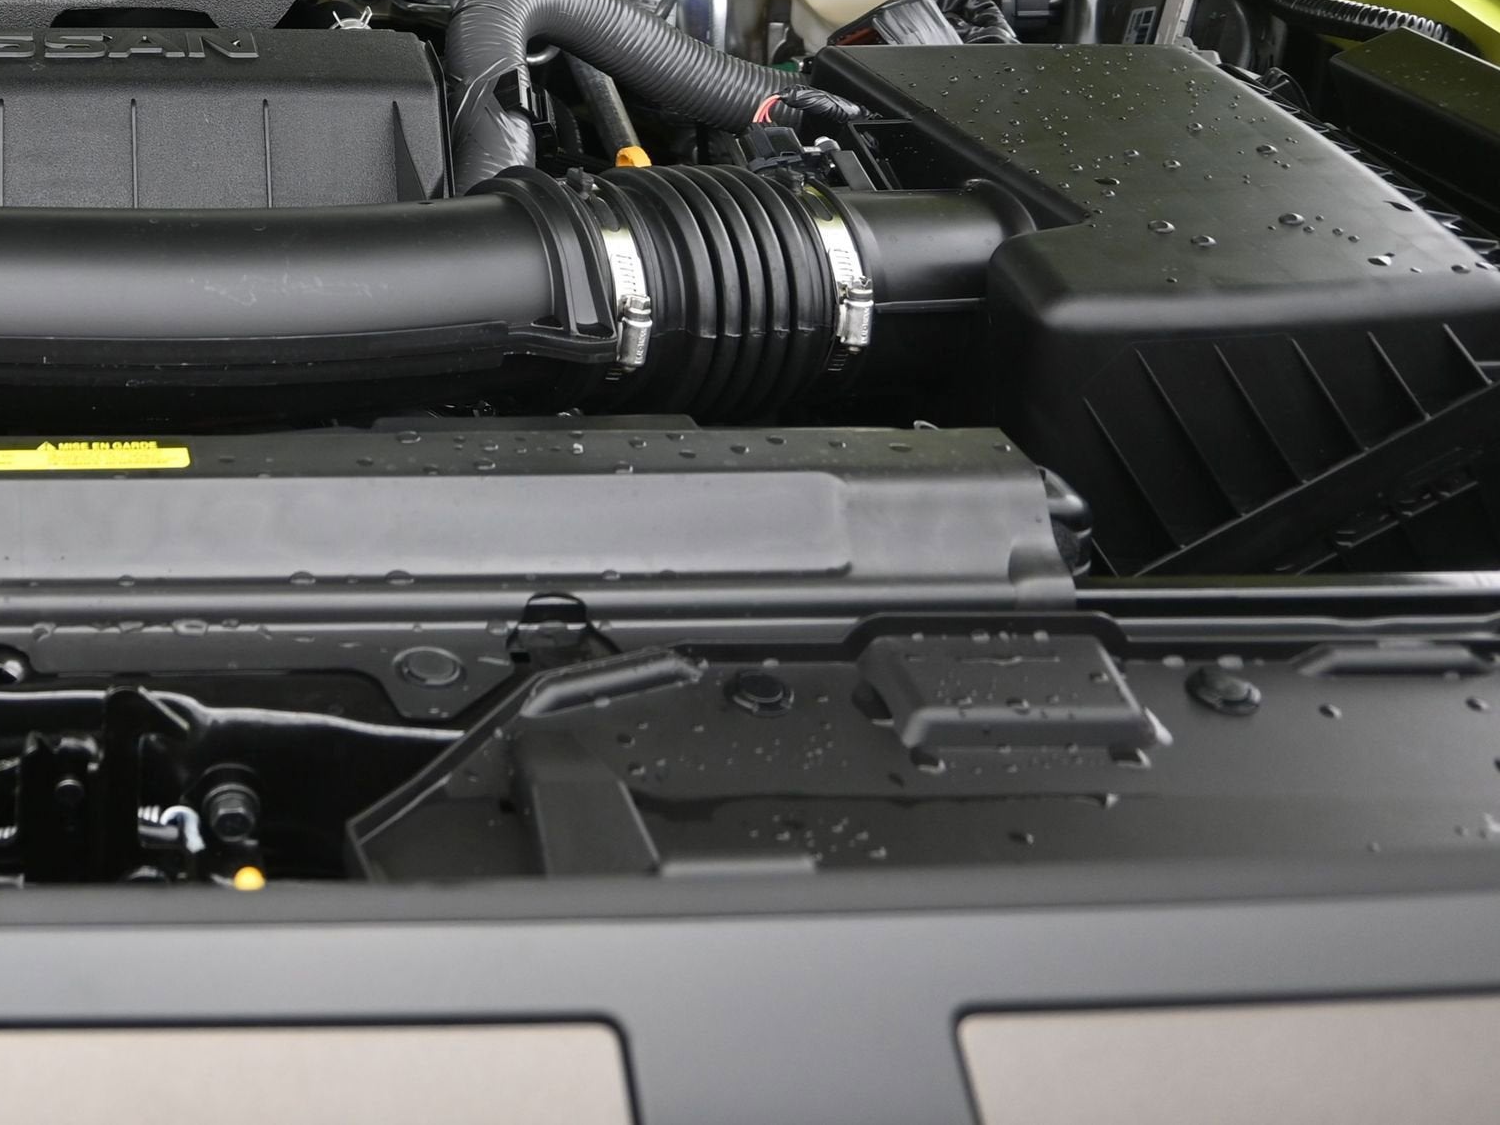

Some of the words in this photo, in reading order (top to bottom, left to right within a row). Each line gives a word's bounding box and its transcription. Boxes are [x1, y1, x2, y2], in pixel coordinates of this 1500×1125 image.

[58, 442, 90, 451] MISE
[92, 442, 111, 451] EN
[112, 441, 158, 451] GARDE
